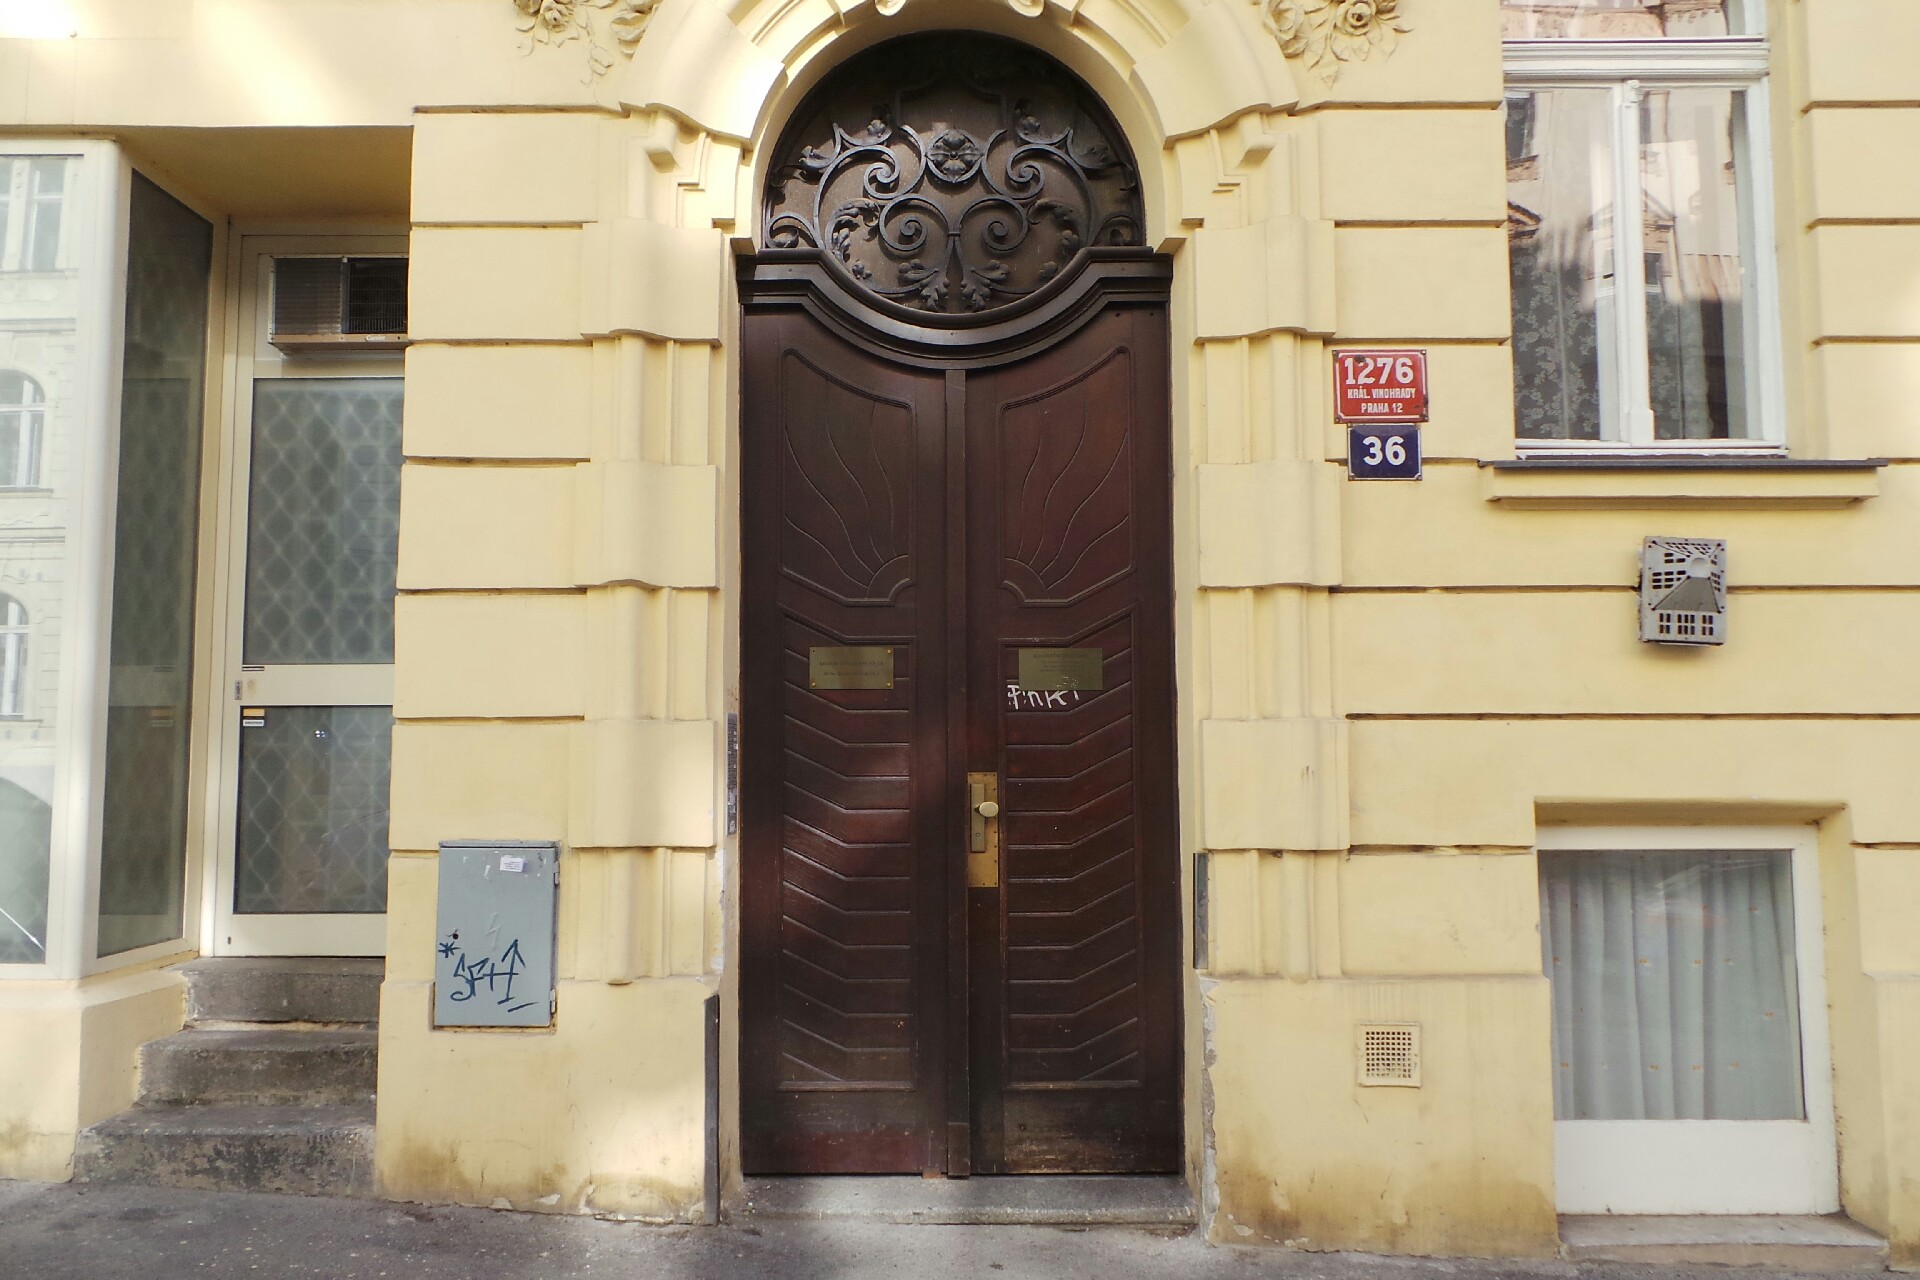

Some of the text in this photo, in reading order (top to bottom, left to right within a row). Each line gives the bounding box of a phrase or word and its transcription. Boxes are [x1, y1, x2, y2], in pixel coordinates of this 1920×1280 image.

[1344, 357, 1414, 385] 1276
[1372, 387, 1416, 399] VINOHRADY
[1361, 402, 1404, 413] PRAHA 12
[1362, 436, 1407, 466] 36
